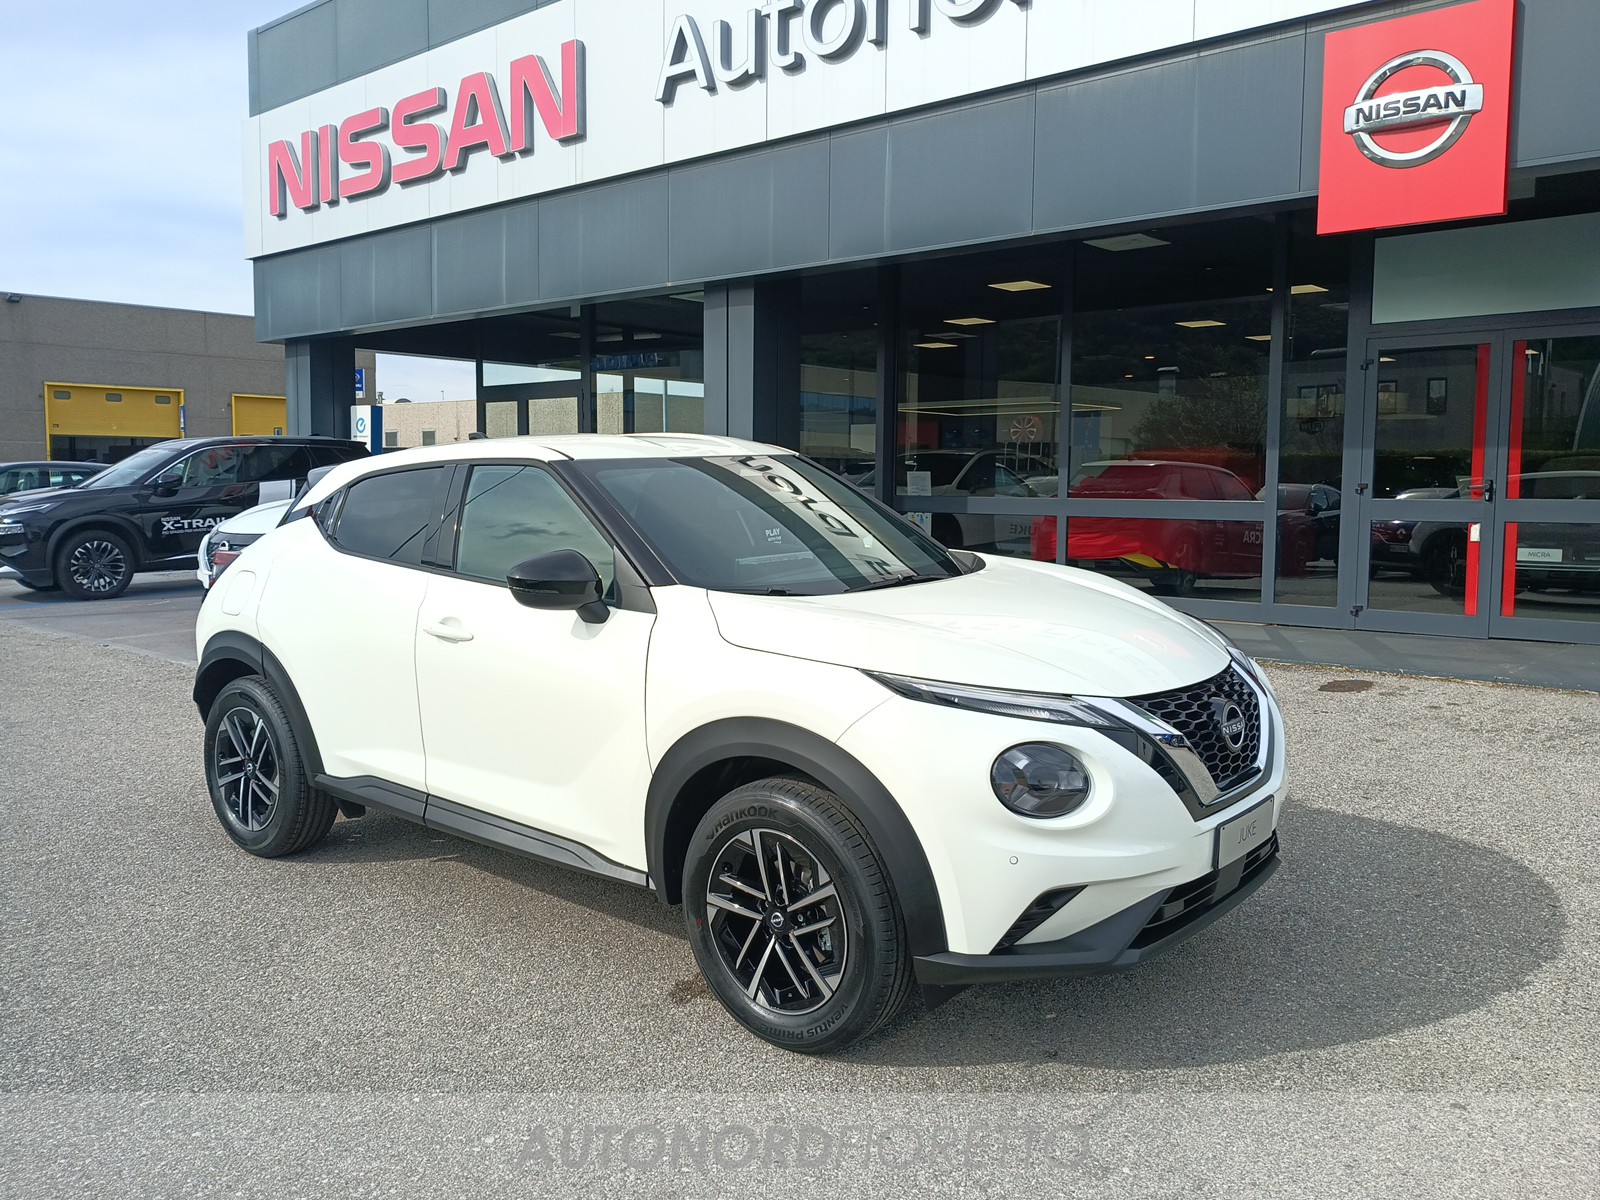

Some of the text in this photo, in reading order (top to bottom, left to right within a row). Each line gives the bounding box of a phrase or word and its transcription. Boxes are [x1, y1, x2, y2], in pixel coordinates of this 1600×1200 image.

[1355, 89, 1467, 125] NISSAN
[268, 39, 584, 219] NISSAN
[765, 528, 780, 537] PLAY
[1237, 820, 1257, 844] JUKE
